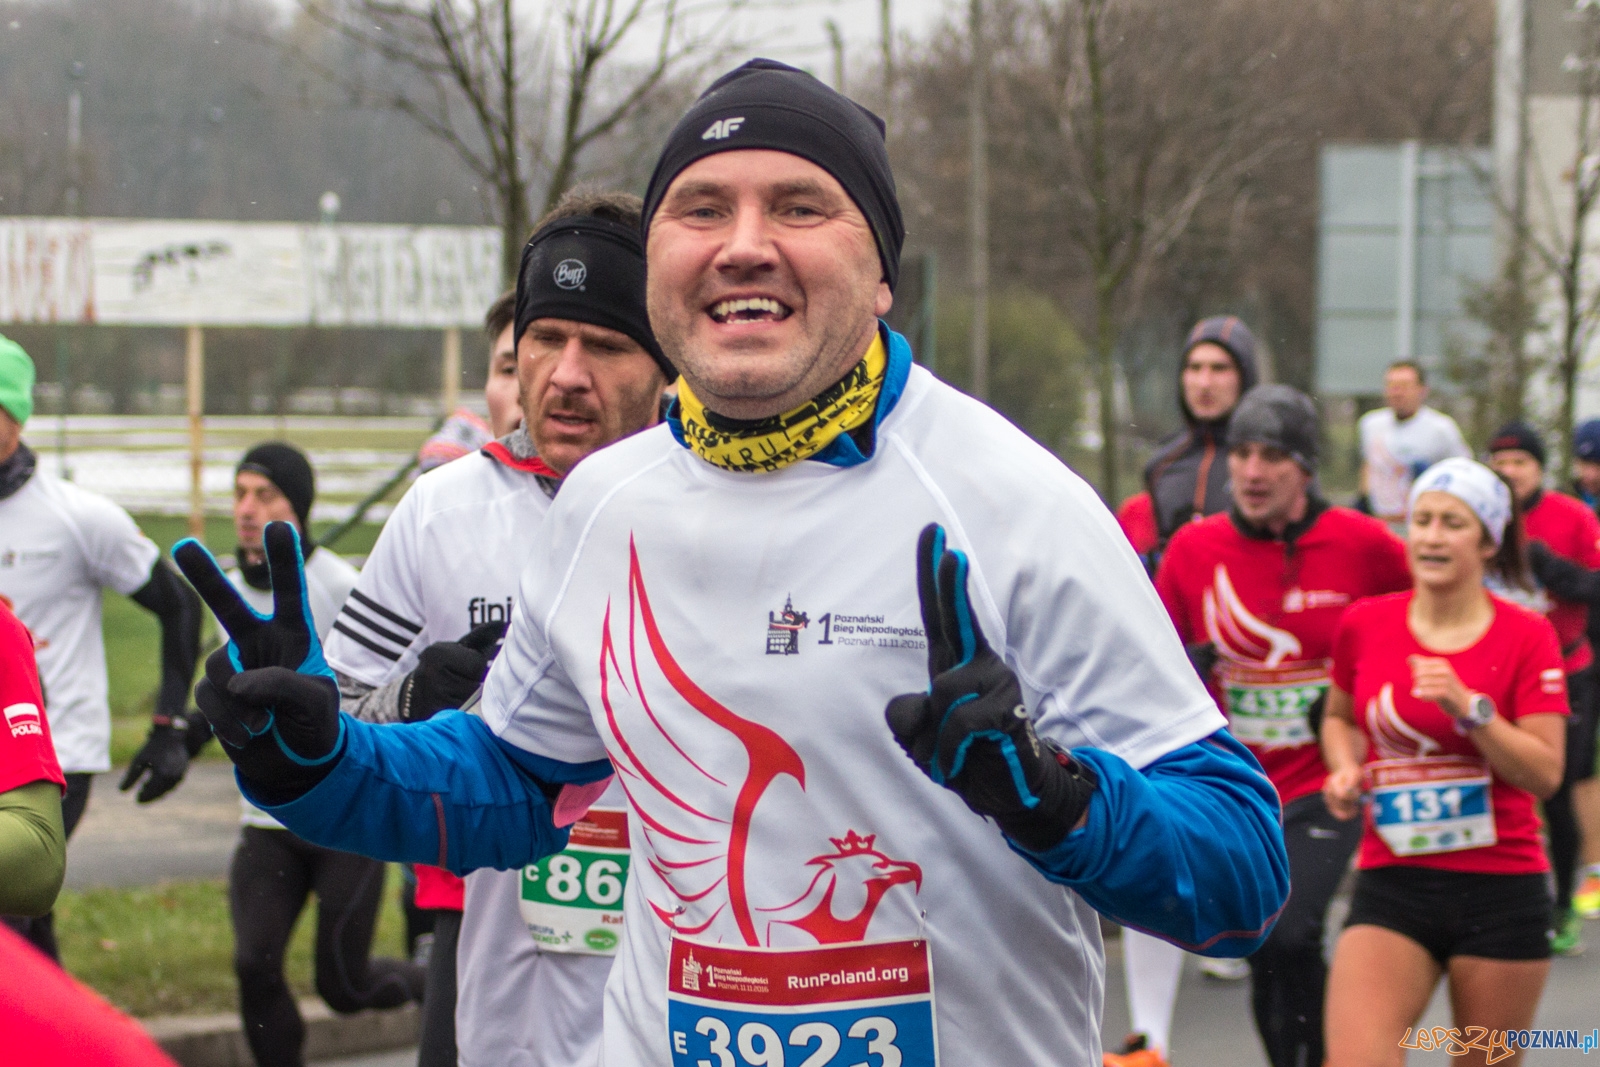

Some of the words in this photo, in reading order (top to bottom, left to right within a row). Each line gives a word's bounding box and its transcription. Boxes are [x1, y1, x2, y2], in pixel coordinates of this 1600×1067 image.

[702, 116, 746, 140] 4F
[817, 612, 834, 645] 1
[833, 625, 854, 634] Bieg
[834, 614, 885, 624] Poznański
[1391, 788, 1461, 821] 131
[545, 854, 629, 905] 86
[706, 964, 717, 988] 1
[787, 967, 909, 989] RunPoland.org
[673, 1030, 688, 1055] E
[694, 1016, 903, 1067] 3923
